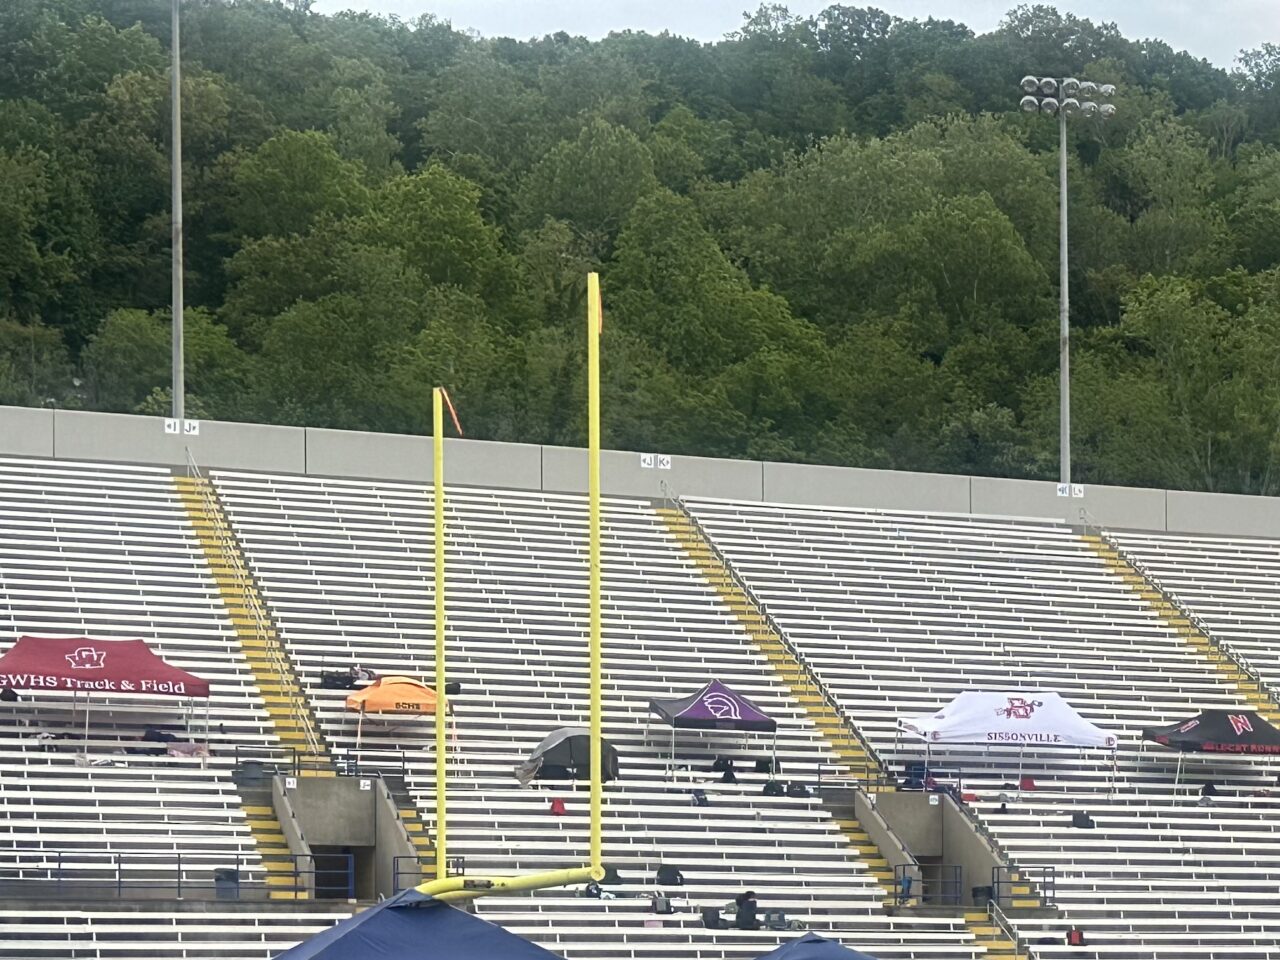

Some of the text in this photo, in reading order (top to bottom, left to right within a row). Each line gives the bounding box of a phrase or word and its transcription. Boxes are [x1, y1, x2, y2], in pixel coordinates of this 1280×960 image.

[62, 677, 116, 691] Track
[120, 681, 135, 691] &
[141, 680, 186, 694] Field
[987, 732, 1063, 743] SISSONVILLE
